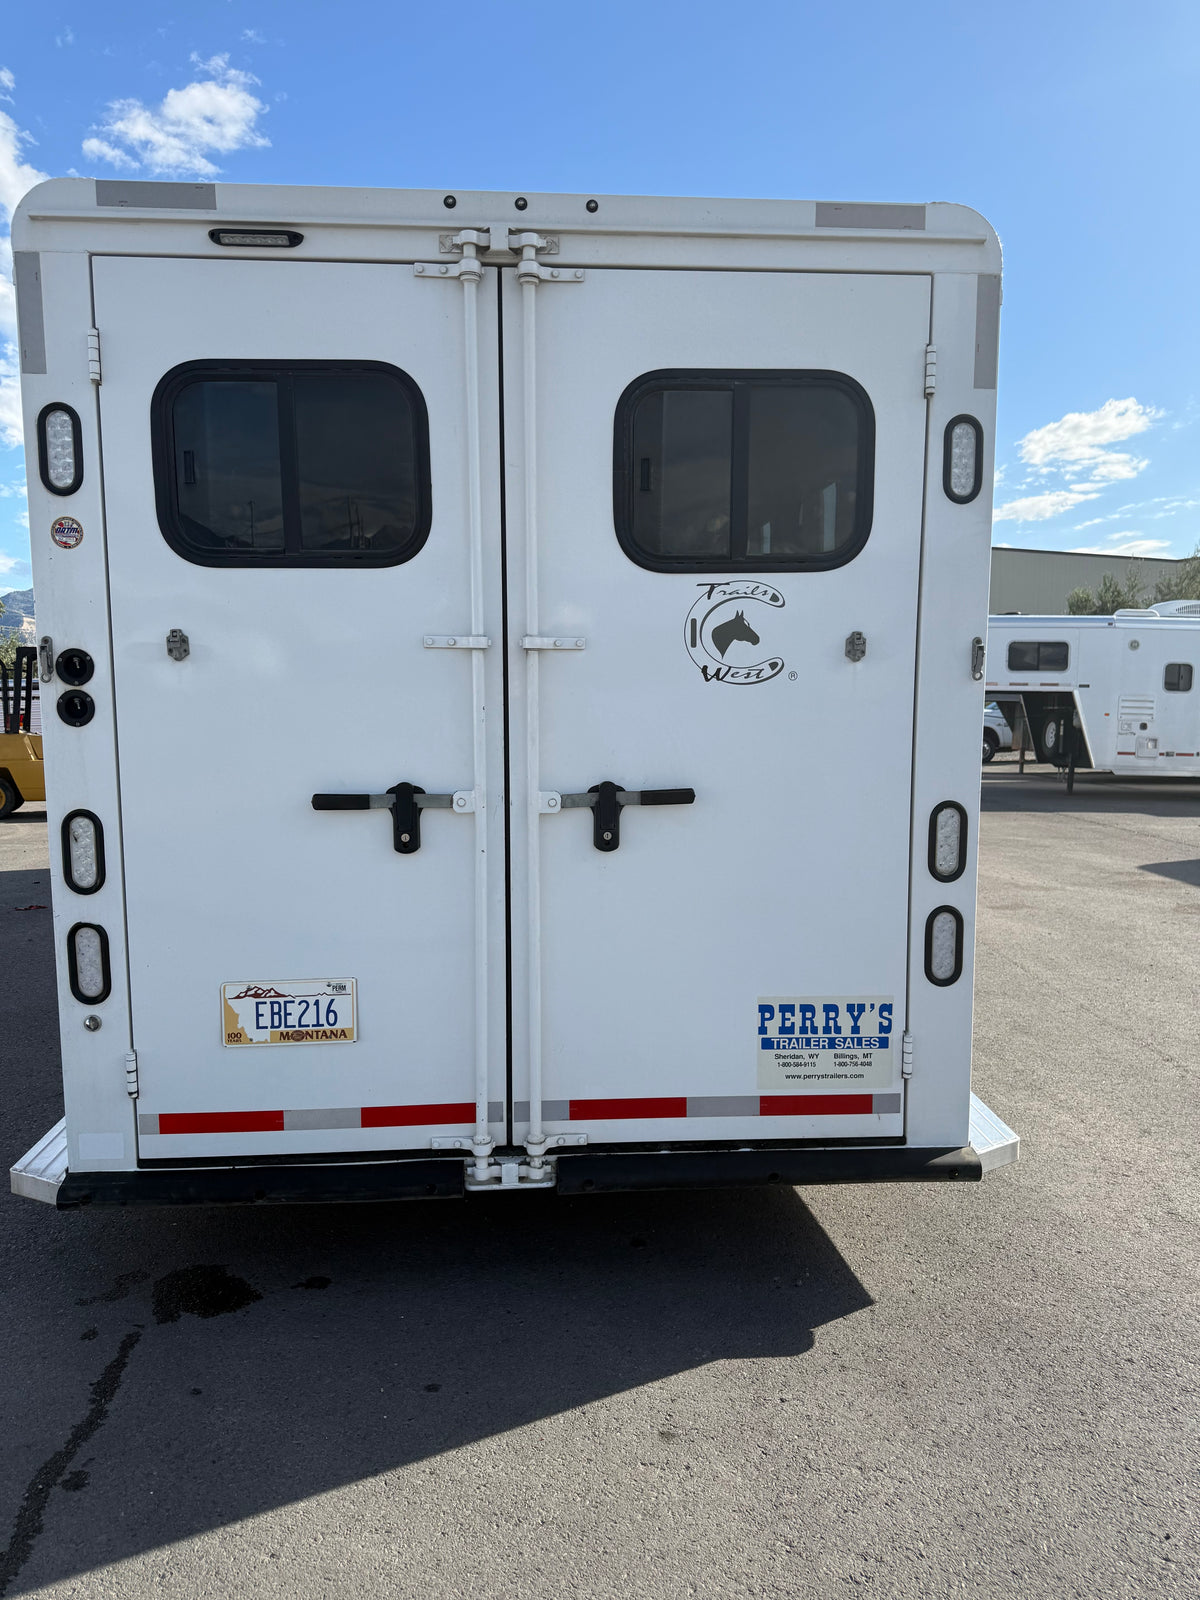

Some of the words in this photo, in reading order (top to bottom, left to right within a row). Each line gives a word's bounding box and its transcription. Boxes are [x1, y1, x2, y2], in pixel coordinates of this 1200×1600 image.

[696, 582, 769, 600] Trails
[701, 664, 765, 682] West
[255, 998, 338, 1030] EBE216
[757, 1002, 894, 1035] PERRY'S
[227, 1031, 242, 1039] 100
[279, 1029, 348, 1042] MONTANA
[771, 1038, 829, 1049] TRAILER
[835, 1037, 880, 1049] SALES
[833, 1052, 859, 1061] Billings,
[784, 1072, 865, 1081] www.perrystrailers.com
